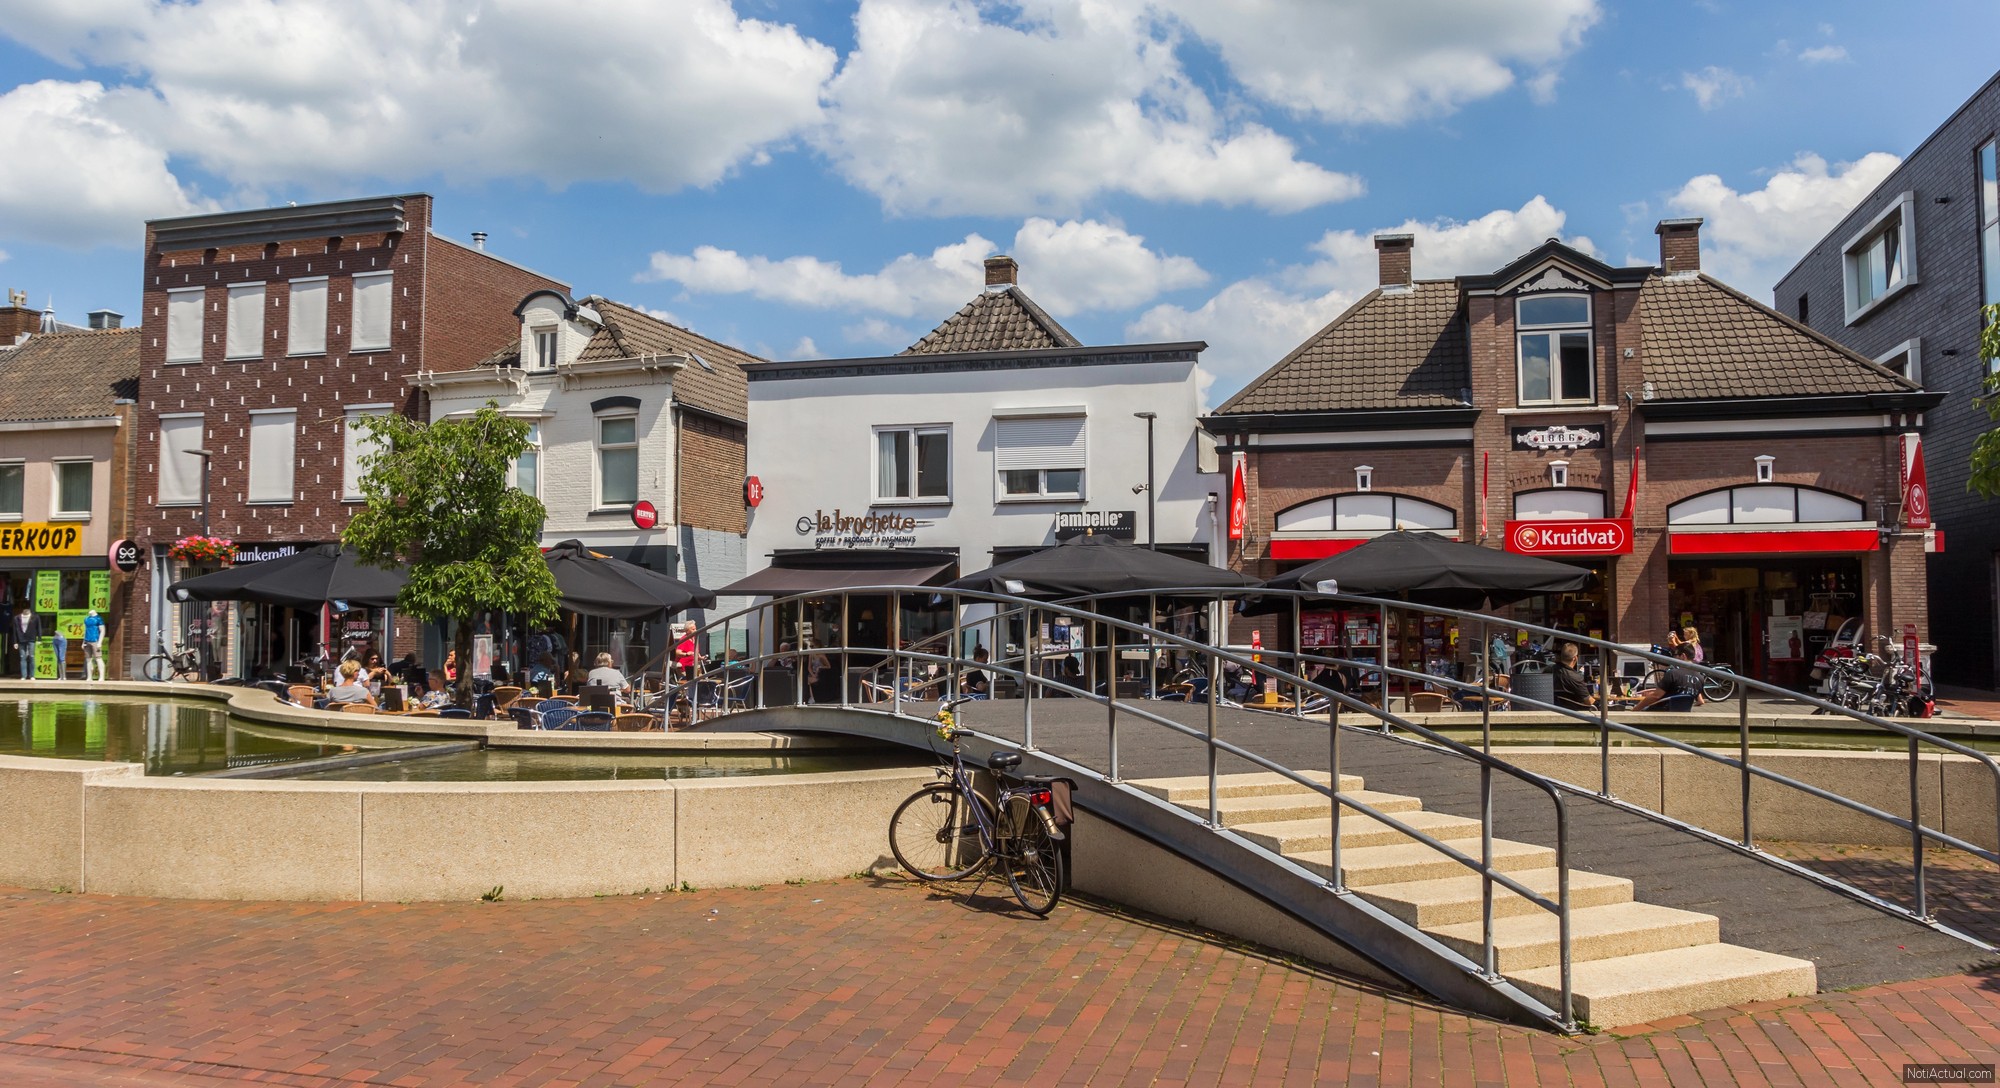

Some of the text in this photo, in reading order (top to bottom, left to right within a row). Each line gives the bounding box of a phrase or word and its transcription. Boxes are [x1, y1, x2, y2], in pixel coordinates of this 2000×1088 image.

[1541, 433, 1575, 442] 1886
[816, 509, 917, 535] la brochette
[0, 527, 76, 551] ERKOOP
[1541, 528, 1616, 546] Kruidvat
[232, 545, 299, 561] unkemöll
